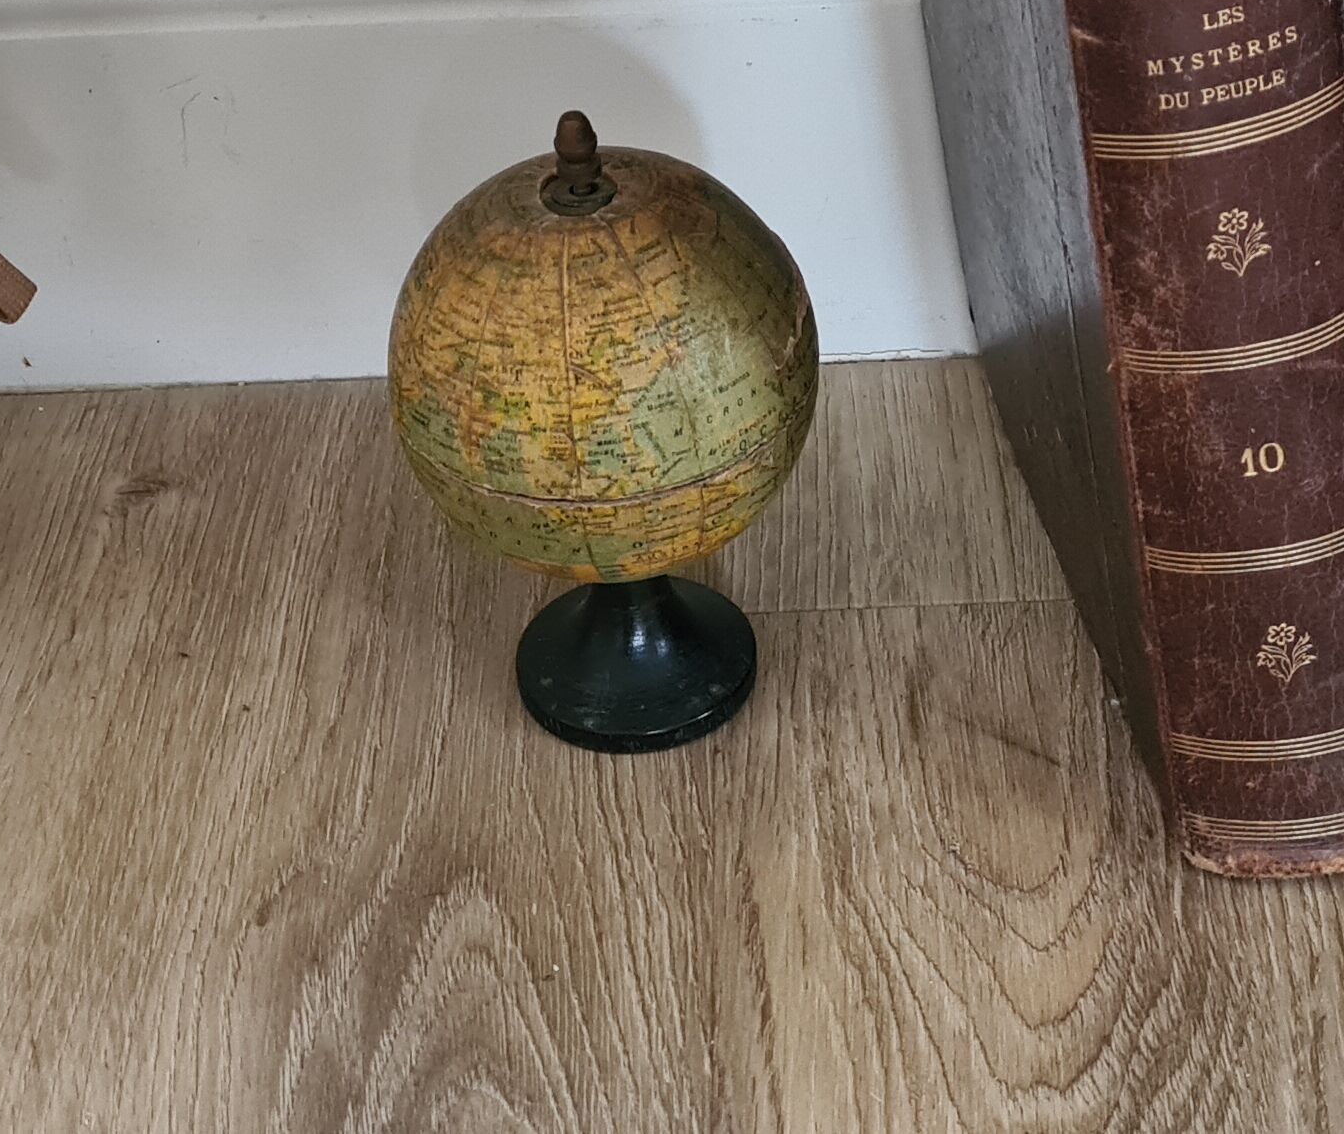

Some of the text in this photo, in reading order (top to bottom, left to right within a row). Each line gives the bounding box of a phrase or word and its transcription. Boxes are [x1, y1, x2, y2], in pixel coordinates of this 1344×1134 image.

[1202, 6, 1245, 30] LES
[1147, 26, 1298, 76] MYSTÈRES
[1159, 69, 1285, 110] DU PEUPLE
[1241, 442, 1285, 477] 10
